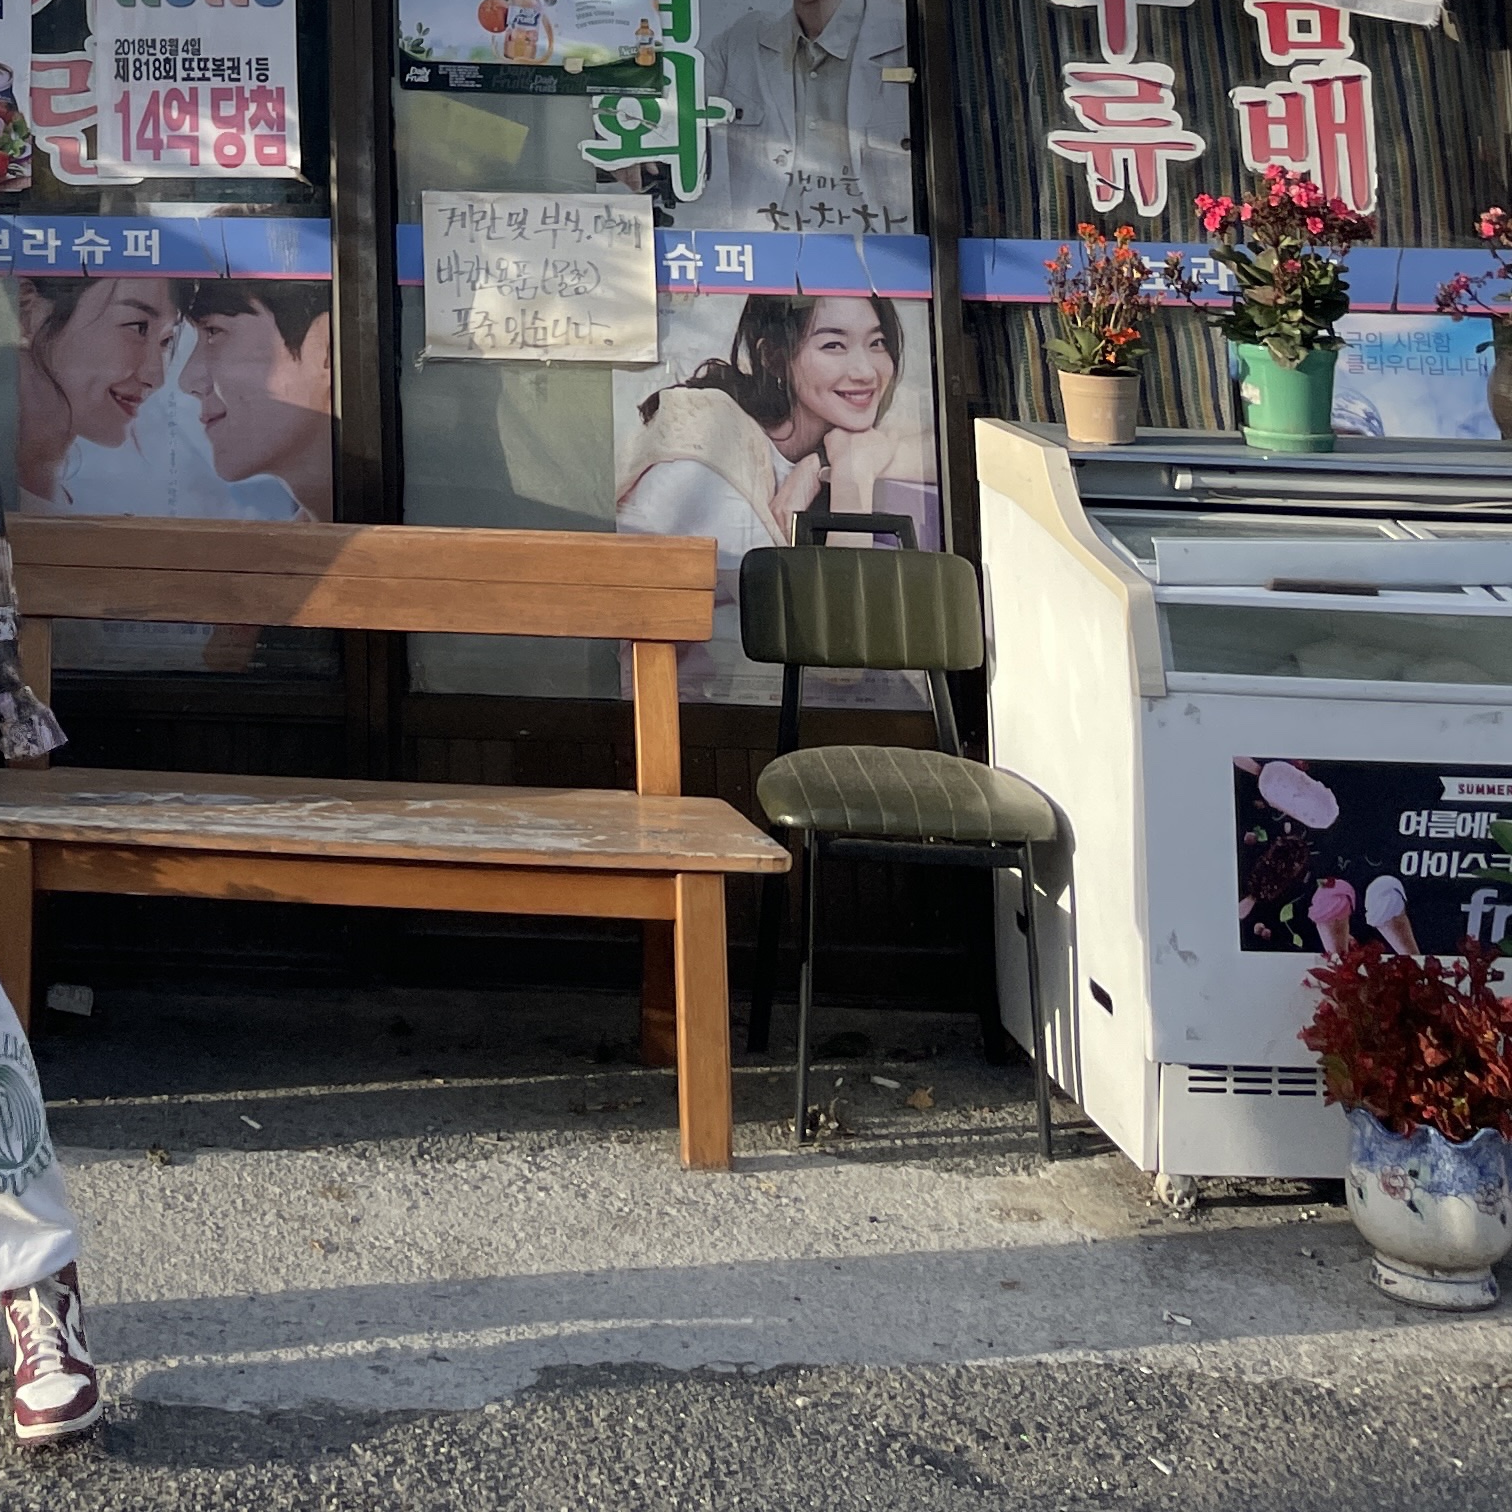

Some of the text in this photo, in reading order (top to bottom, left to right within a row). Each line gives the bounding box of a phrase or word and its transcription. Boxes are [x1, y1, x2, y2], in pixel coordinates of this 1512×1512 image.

[114, 38, 202, 57] 2018년 8월 4일
[114, 57, 270, 83] 제 818회 또또복권 1등
[113, 85, 288, 169] 14억 당첨
[784, 165, 863, 197] 갯마을
[438, 202, 506, 244] 계란
[506, 206, 531, 241] 및
[757, 202, 909, 233] 차차차
[451, 306, 499, 351] 폭죽
[1392, 331, 1452, 353] 시원함
